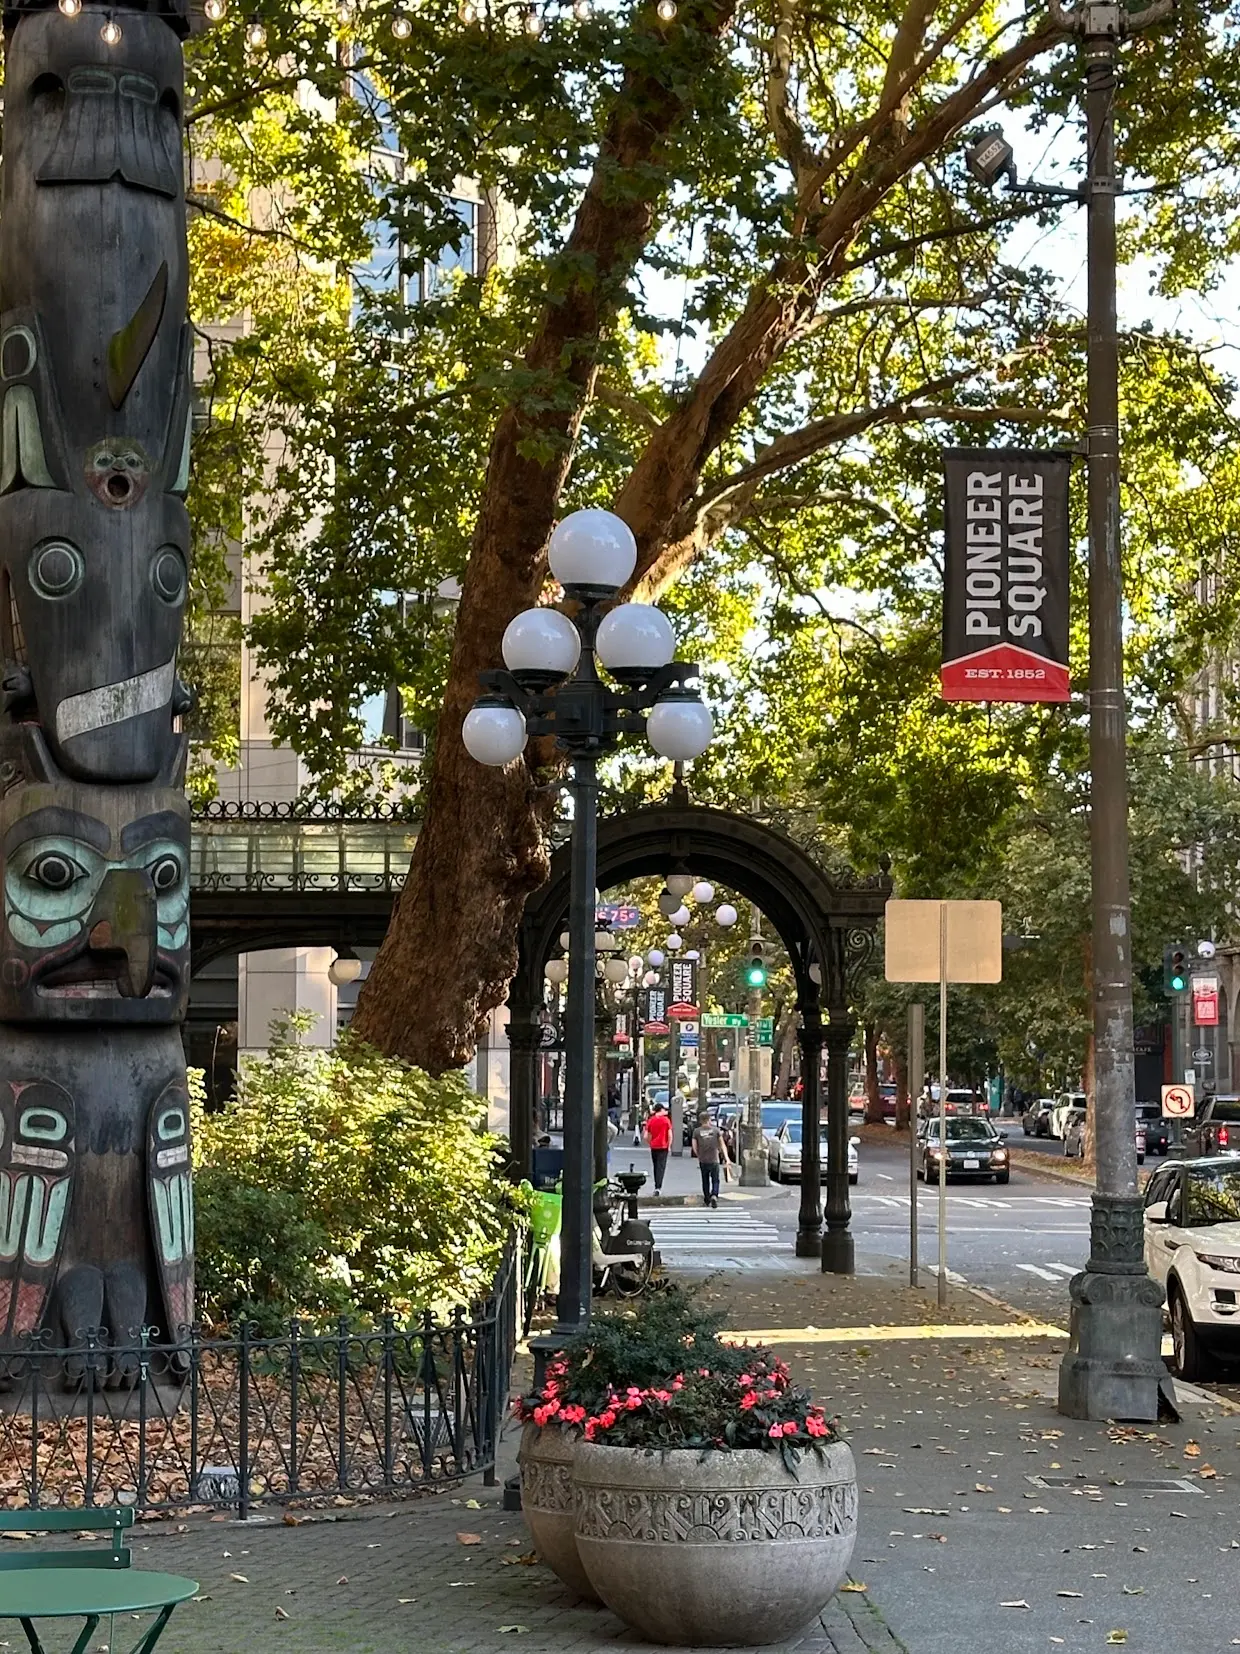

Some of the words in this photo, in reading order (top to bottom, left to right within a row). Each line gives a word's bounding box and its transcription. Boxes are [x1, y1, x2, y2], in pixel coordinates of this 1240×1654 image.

[966, 471, 1002, 636] PIONEER
[1007, 473, 1047, 638] SQUARE
[673, 962, 683, 1002] PIONEER
[682, 963, 693, 1003] SQUARE
[703, 1014, 728, 1025] Yesler
